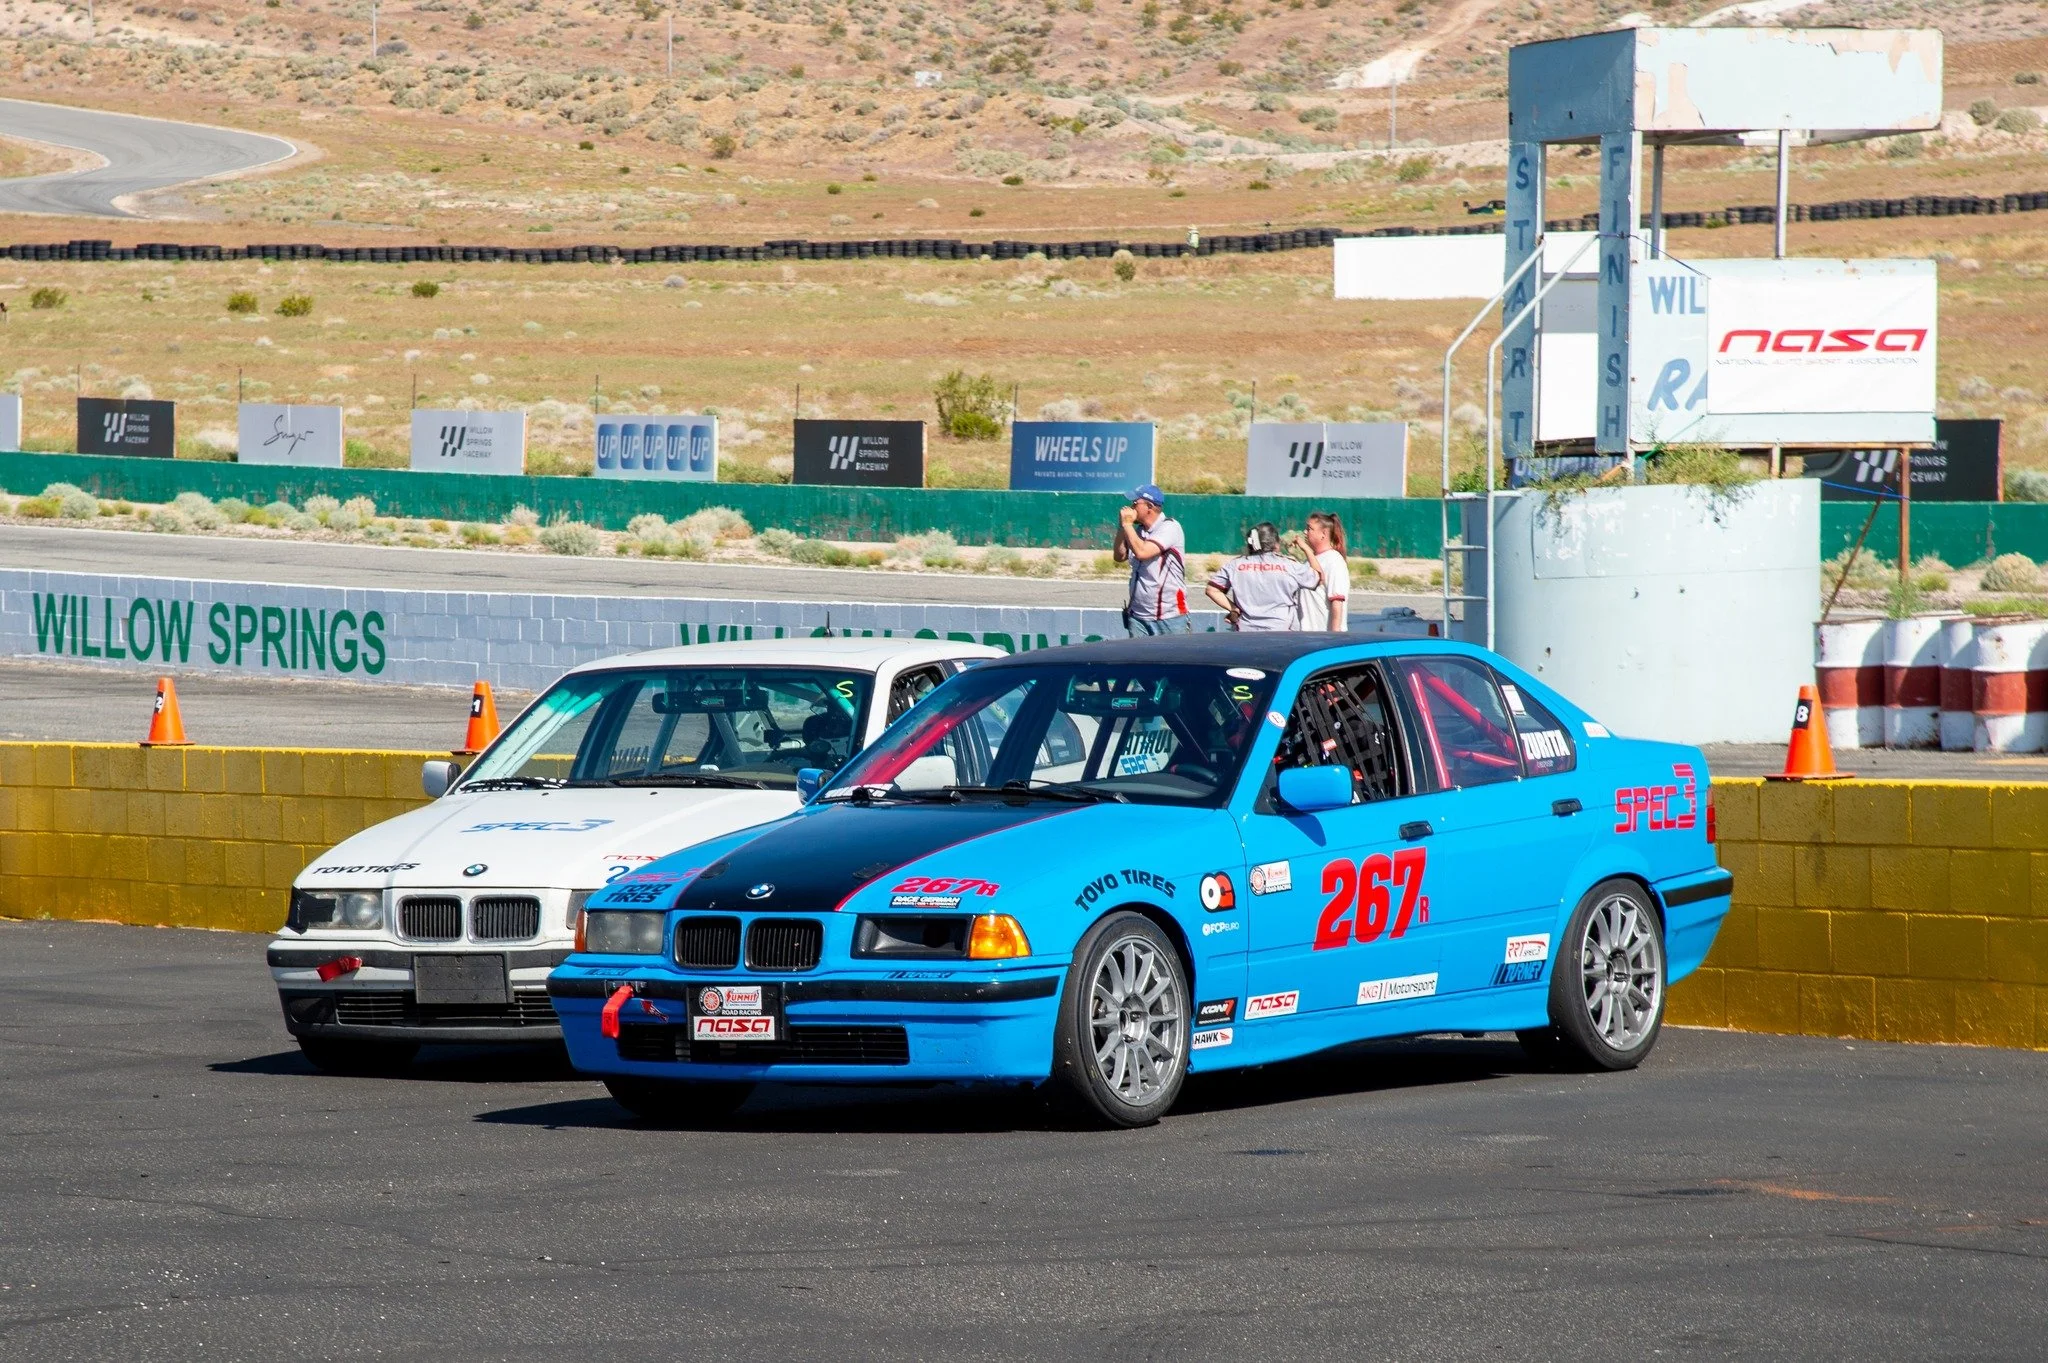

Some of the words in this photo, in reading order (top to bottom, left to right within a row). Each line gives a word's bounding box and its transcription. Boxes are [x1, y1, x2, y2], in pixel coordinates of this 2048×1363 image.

[1604, 145, 1625, 438] FINISH
[1508, 156, 1531, 442] START
[1718, 328, 1928, 353] nasa
[862, 436, 890, 445] WILLOW
[1329, 441, 1363, 450] WILLOW
[599, 435, 618, 459] UP
[621, 435, 641, 459] UP
[644, 435, 663, 459] UP
[668, 436, 687, 460] UP
[691, 437, 711, 461] UP
[858, 449, 890, 459] SPRINGS
[1035, 436, 1103, 462] WHEELS
[1105, 437, 1129, 463] UP
[855, 462, 889, 471] RACEWAY
[1325, 455, 1362, 465] SPRINGS
[1321, 469, 1362, 479] RACEWAY
[1237, 563, 1288, 572] OFFICIAL
[33, 593, 193, 664] WILLOW
[207, 602, 386, 675] SPRINGS
[1232, 685, 1253, 700] S
[473, 699, 481, 712] 1
[1519, 729, 1571, 760] ZURITA
[312, 866, 364, 874] TOYO
[364, 863, 421, 873] TIRES
[617, 883, 673, 893] TOYO
[1074, 873, 1119, 912] TOYO
[1120, 869, 1177, 899] TIRES
[603, 892, 664, 903] TIRES
[1503, 960, 1543, 983] TURNER
[1248, 993, 1297, 1012] nasa
[697, 1018, 771, 1033] nasa
[1194, 1032, 1219, 1044] HAWK
